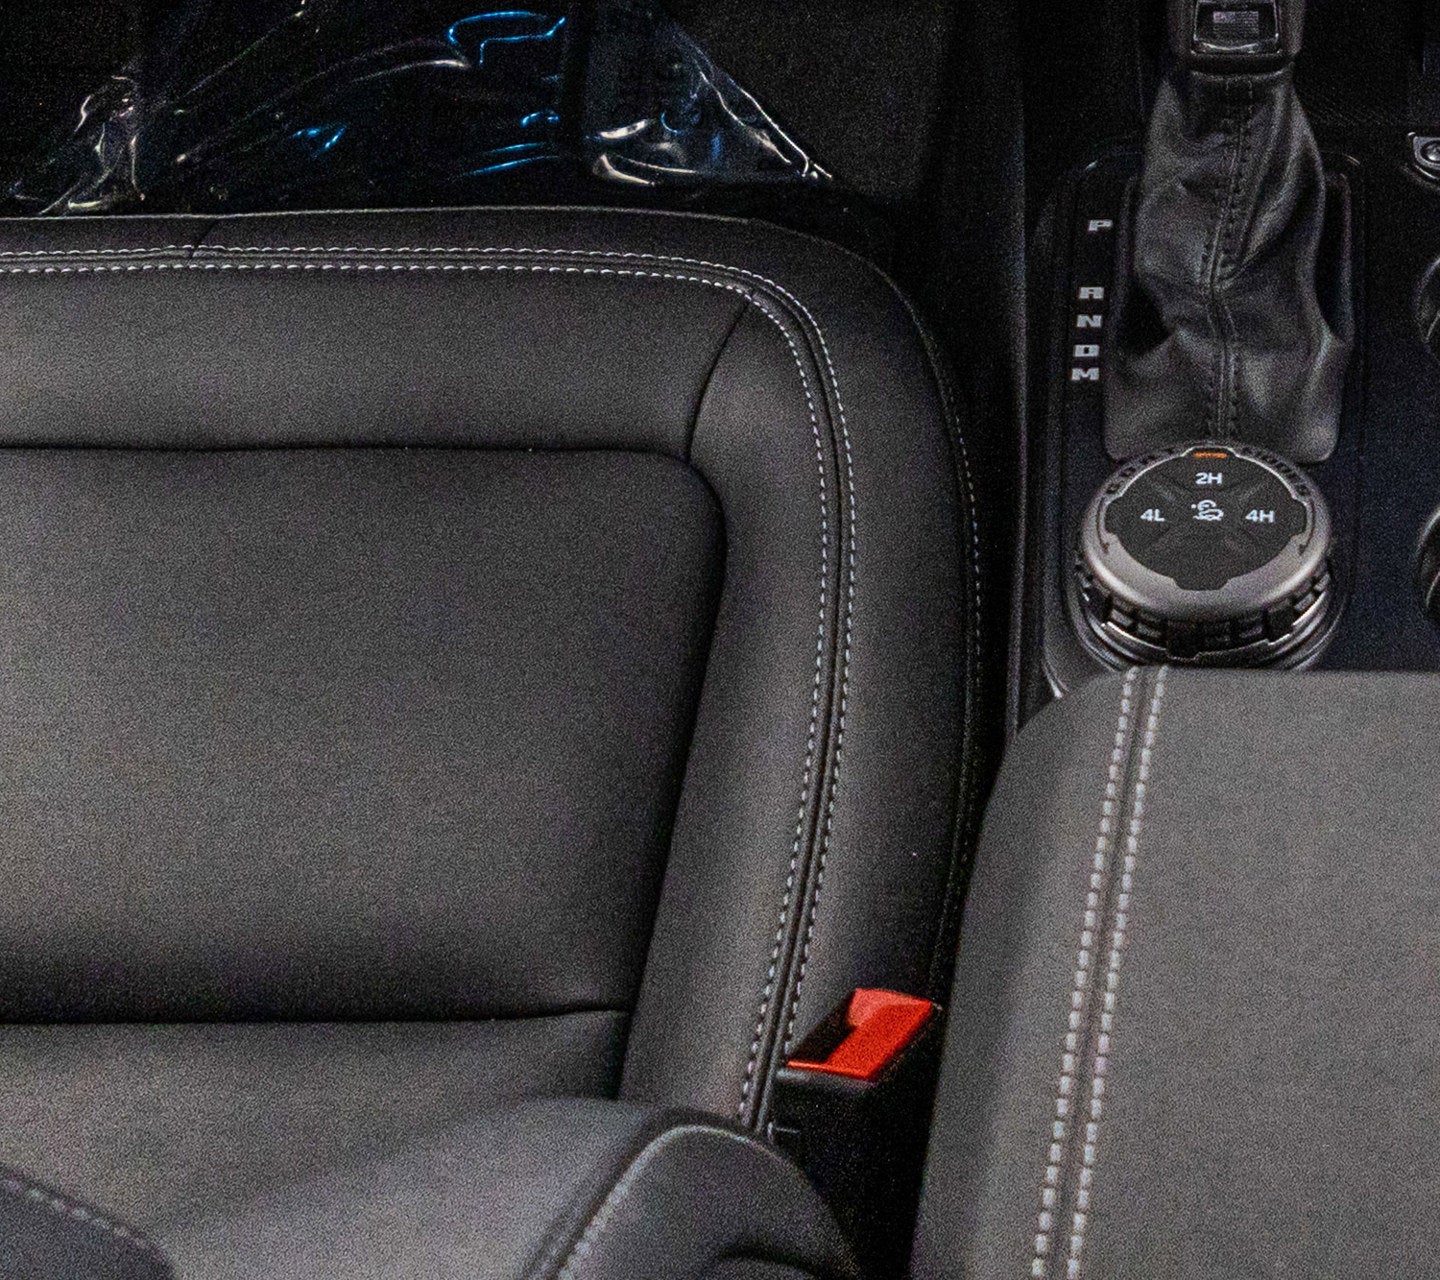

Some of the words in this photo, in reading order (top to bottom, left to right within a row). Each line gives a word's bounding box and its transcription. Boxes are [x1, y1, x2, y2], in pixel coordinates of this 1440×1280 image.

[1087, 219, 1113, 232] P
[1078, 286, 1104, 300] R
[1076, 314, 1103, 328] N
[1074, 344, 1100, 358] D
[1071, 367, 1099, 381] M
[1195, 472, 1223, 485] 2H
[1140, 508, 1165, 523] 4L
[1245, 509, 1275, 523] 4H
